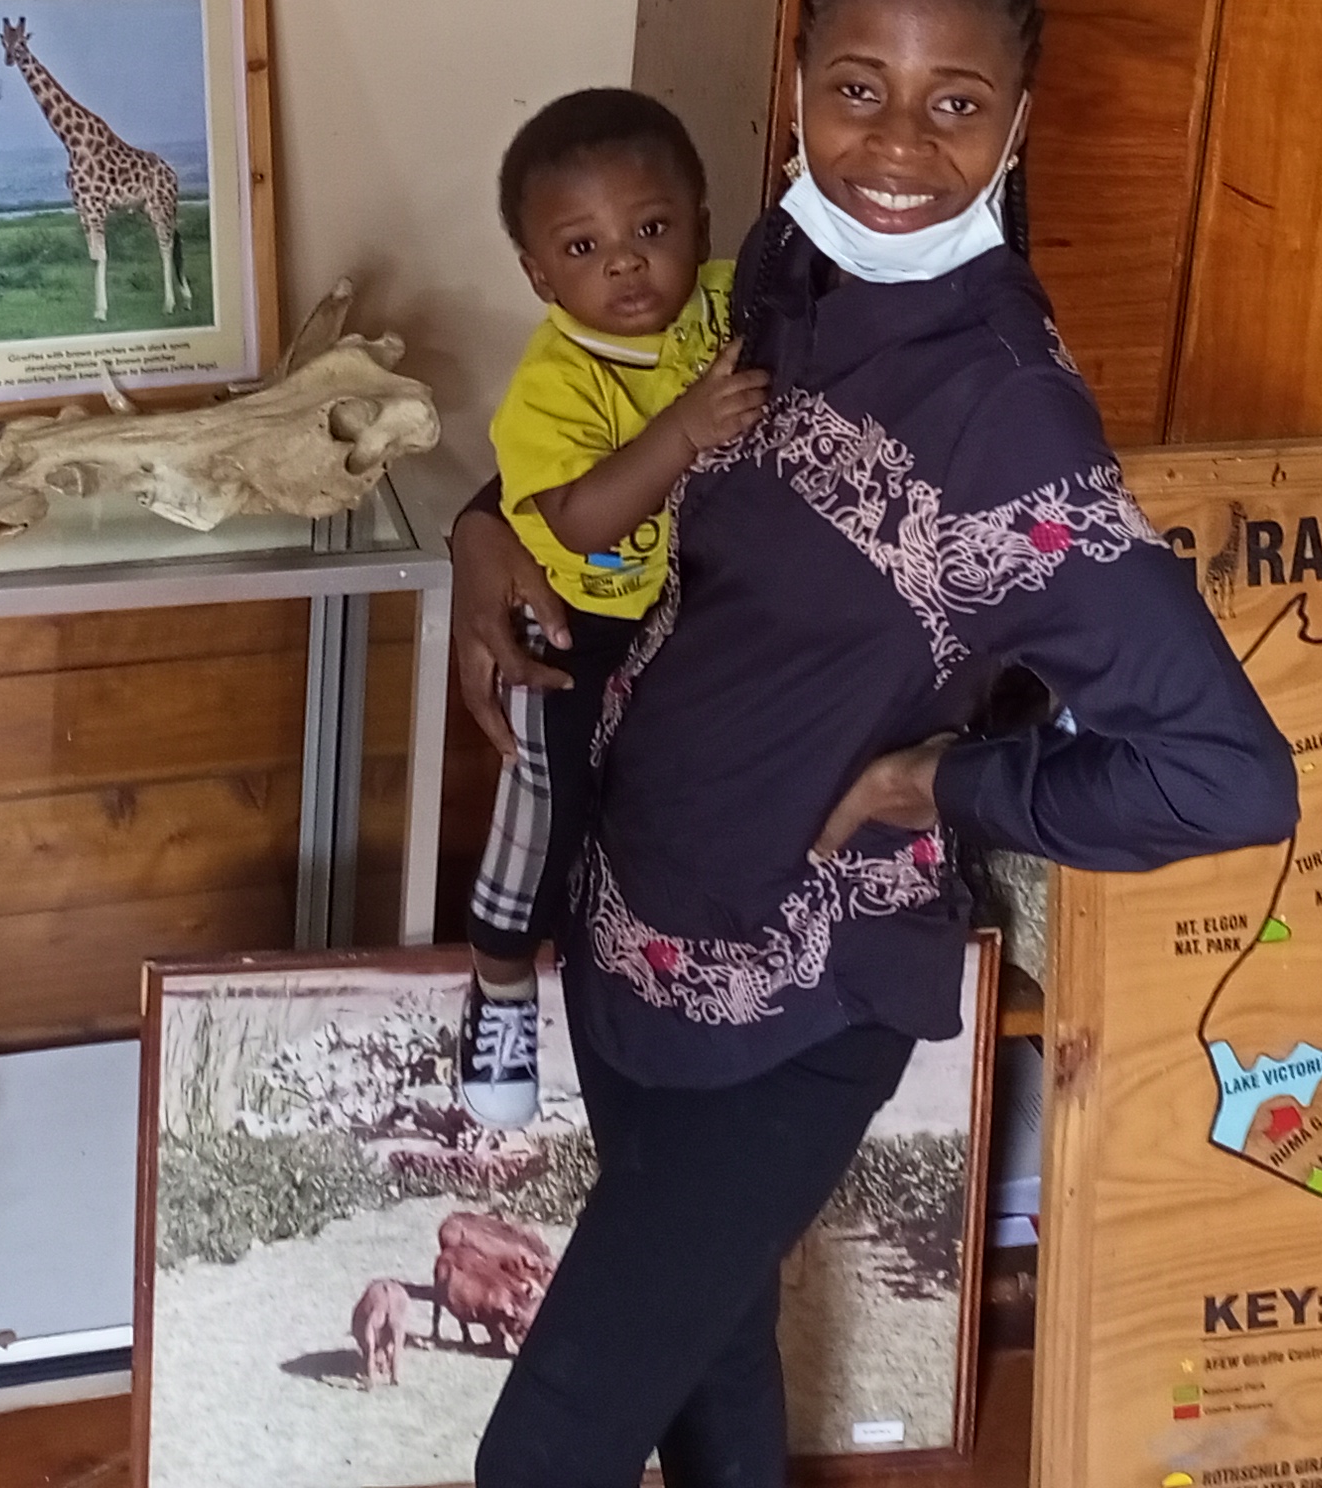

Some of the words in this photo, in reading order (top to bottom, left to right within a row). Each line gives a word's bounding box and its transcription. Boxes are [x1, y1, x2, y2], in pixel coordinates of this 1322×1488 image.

[1175, 920, 1201, 937] MT.
[1203, 914, 1249, 932] ELGON
[1174, 940, 1204, 956] NAT.
[1206, 937, 1242, 954] PARK
[1223, 1075, 1260, 1097] LAKE
